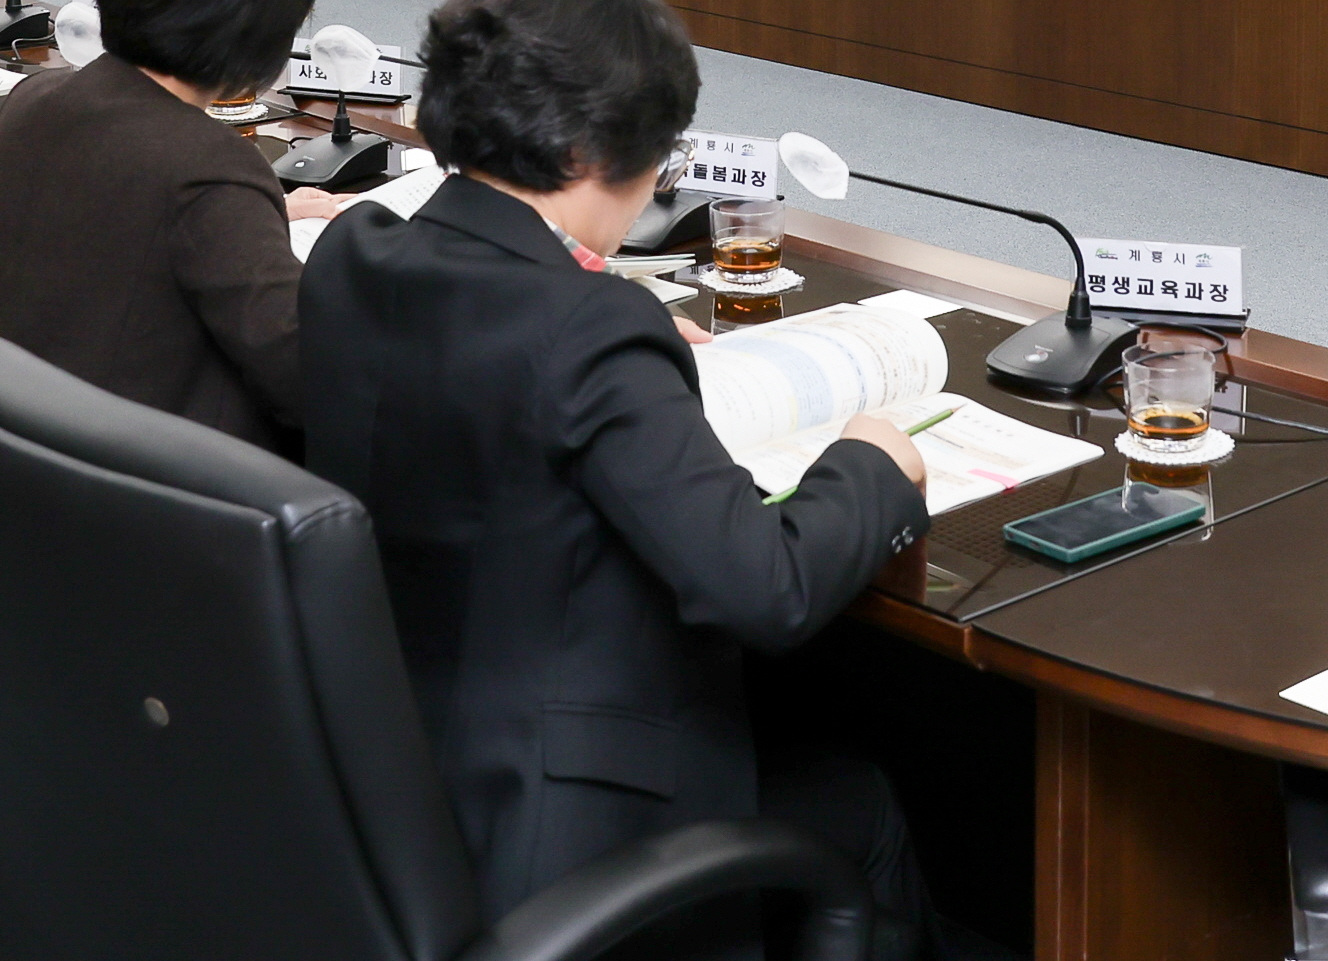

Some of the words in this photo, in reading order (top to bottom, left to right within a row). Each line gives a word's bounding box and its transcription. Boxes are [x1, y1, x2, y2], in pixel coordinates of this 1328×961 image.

[689, 137, 734, 154] 계룡시
[683, 162, 767, 188] 돌봄과장
[1128, 248, 1186, 265] 계룡시
[1087, 274, 1229, 303] 평생교육과장
